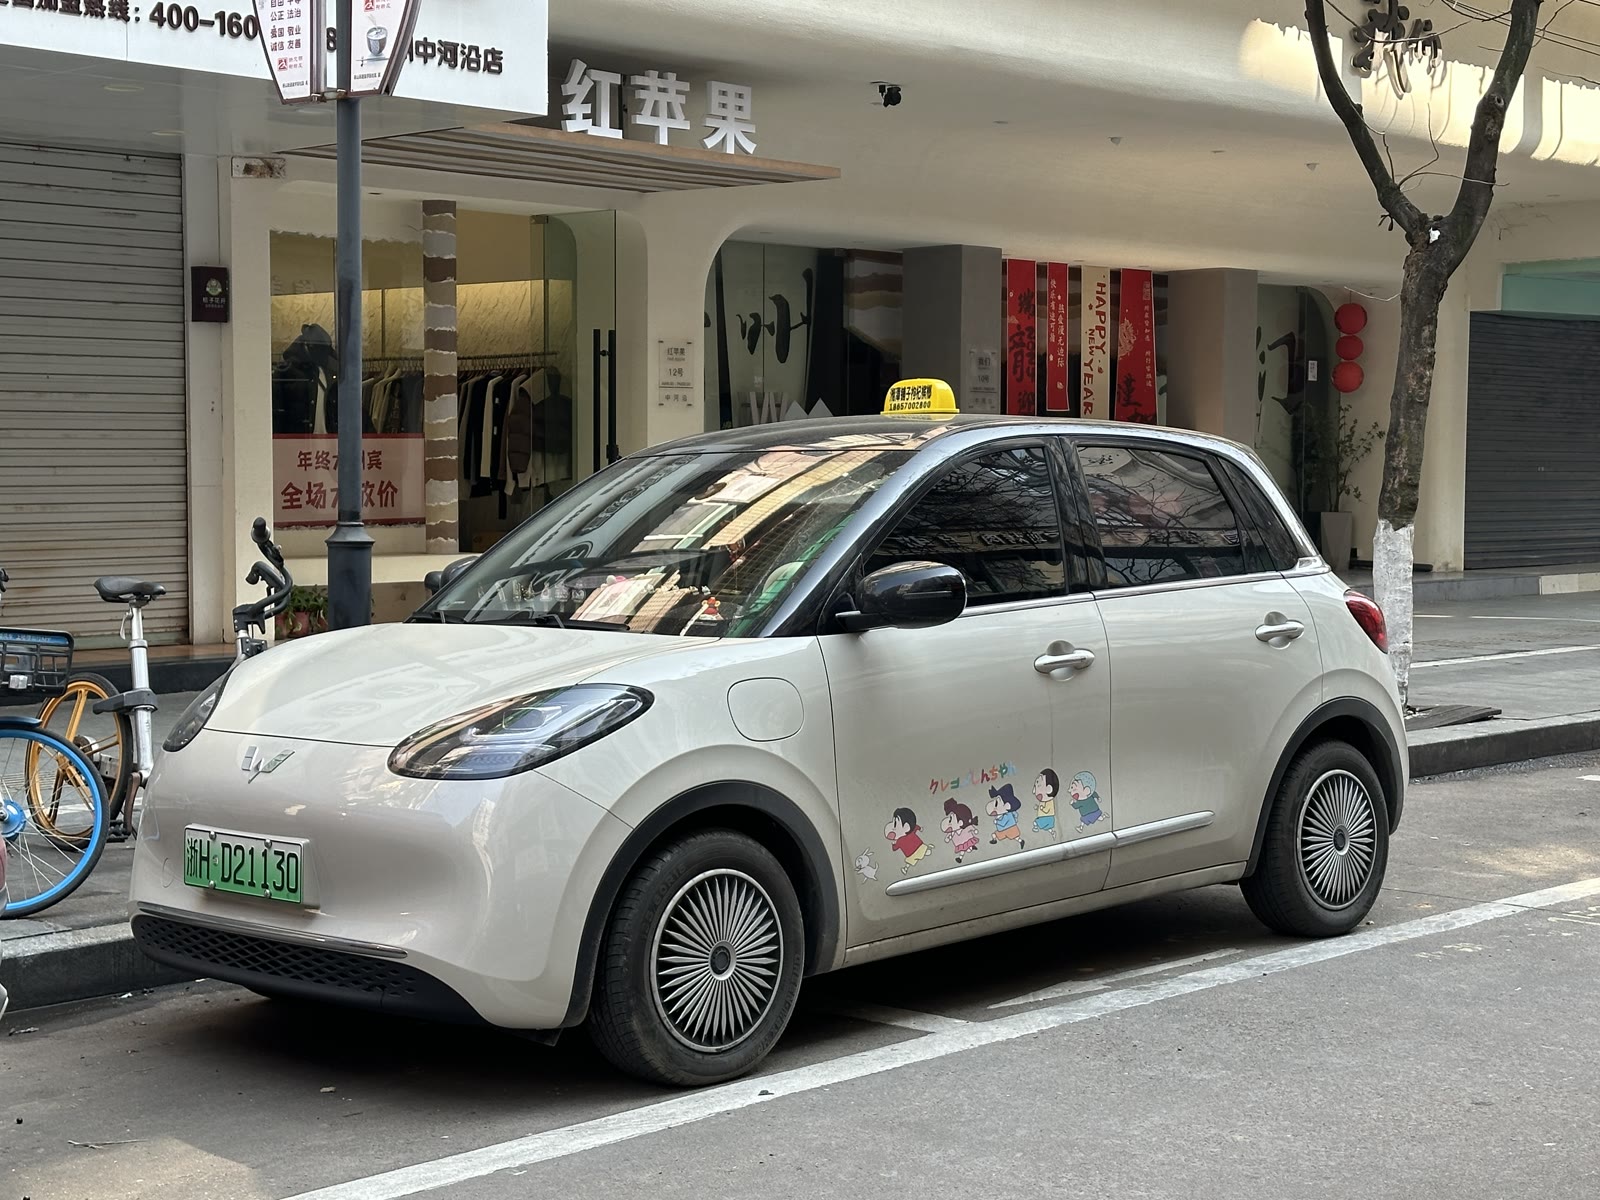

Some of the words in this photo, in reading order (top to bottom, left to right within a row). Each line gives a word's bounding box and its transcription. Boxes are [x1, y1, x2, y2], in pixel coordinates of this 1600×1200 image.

[270, 11, 284, 21] 公正
[287, 8, 301, 19] 法治
[271, 25, 284, 38] 爱国
[287, 25, 301, 36] 敬业
[271, 41, 284, 51] 诚信
[561, 58, 757, 154] 红苹果
[1095, 282, 1107, 355] HAPPY
[1083, 358, 1094, 415] YEAR
[297, 450, 383, 471] 年终宾
